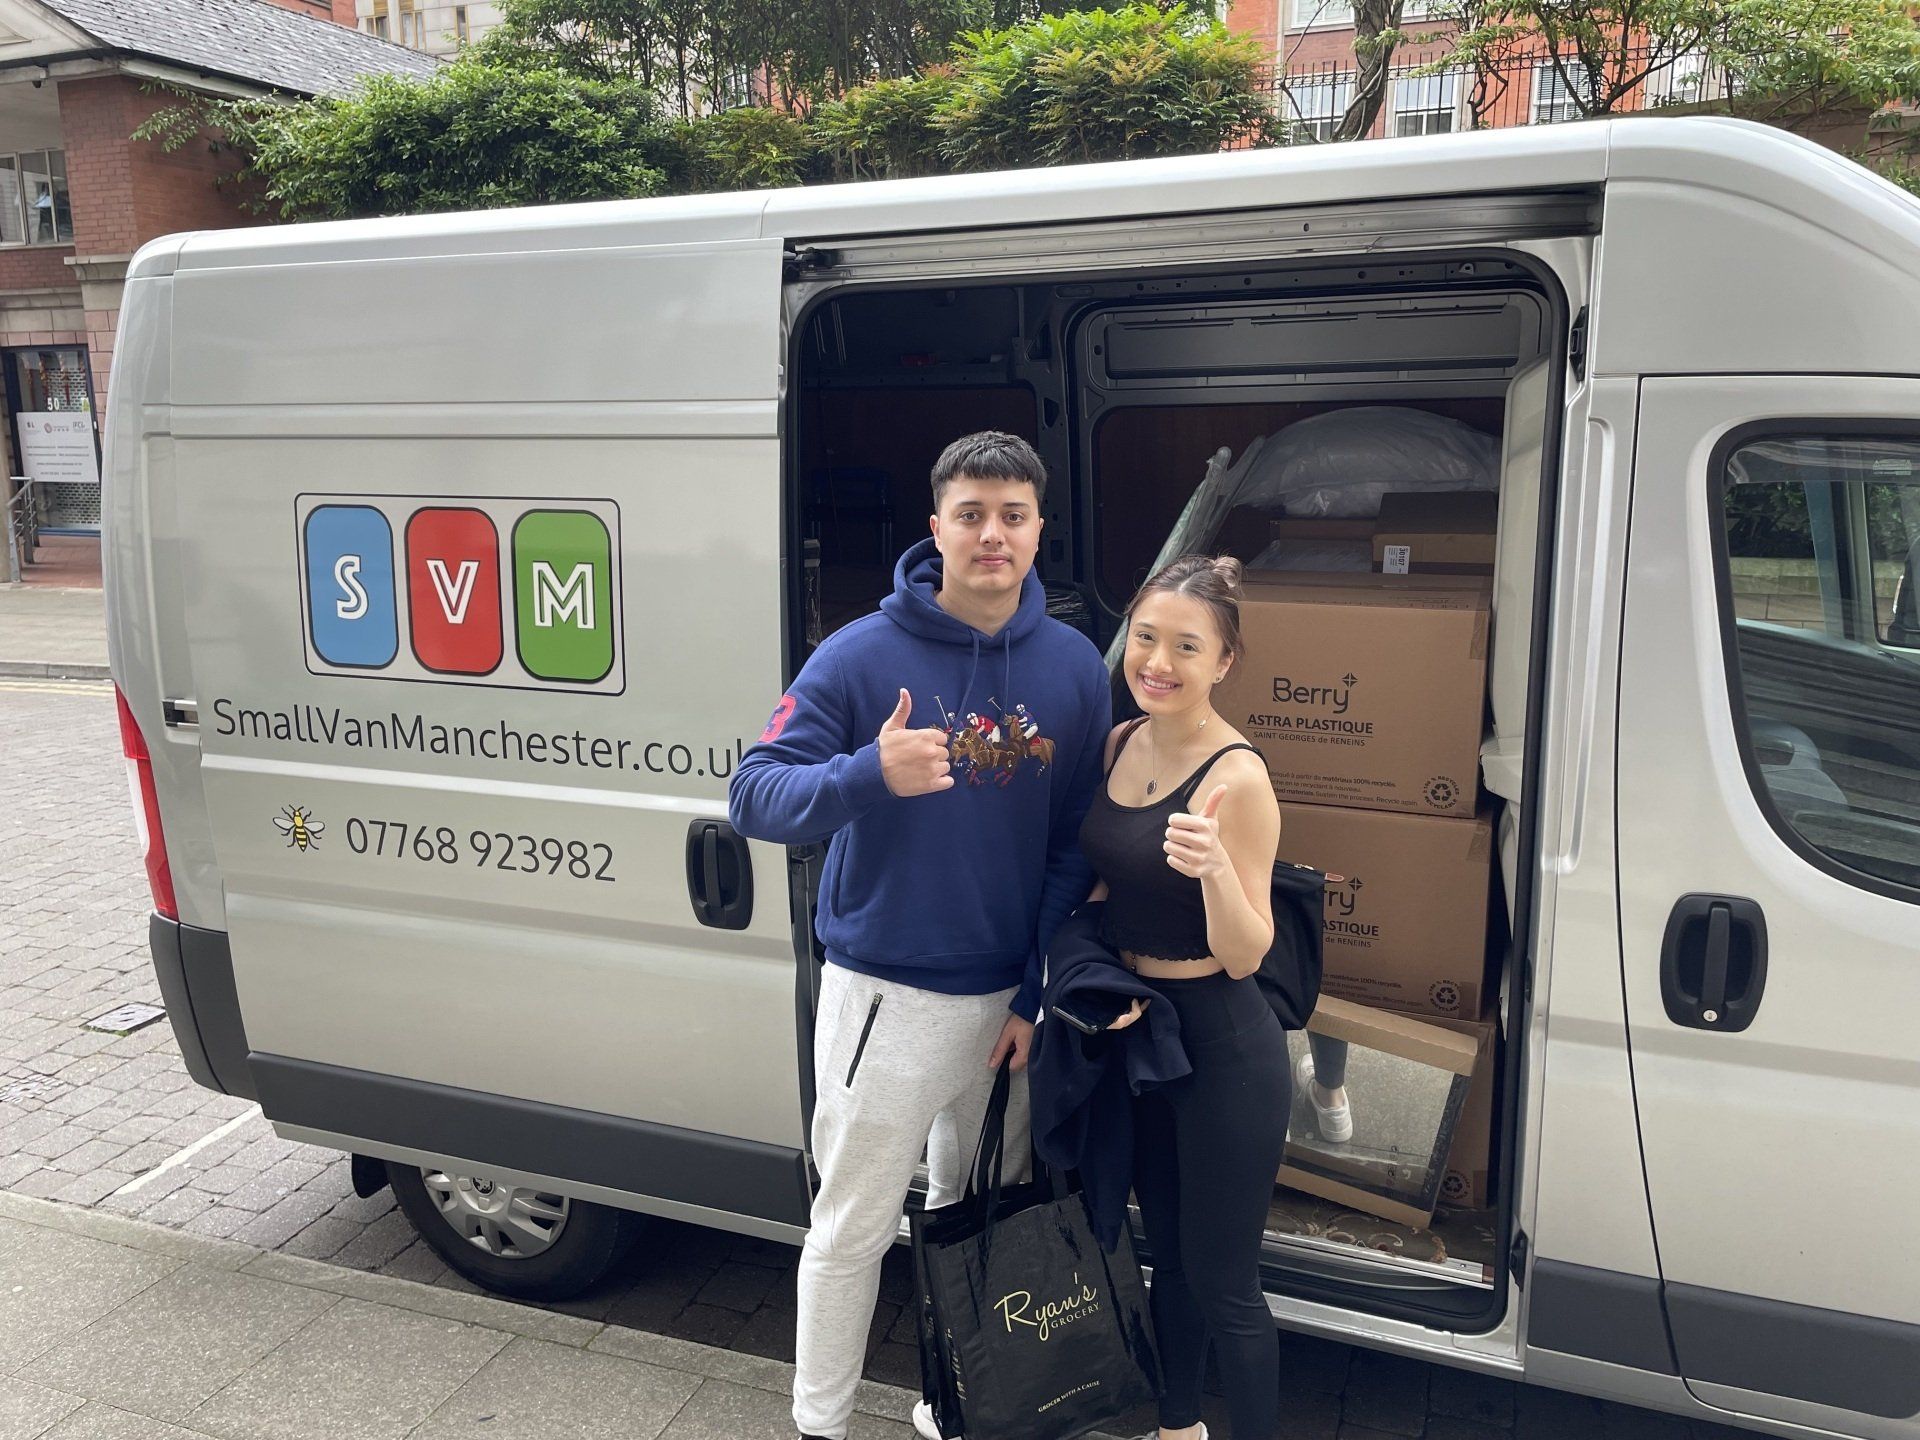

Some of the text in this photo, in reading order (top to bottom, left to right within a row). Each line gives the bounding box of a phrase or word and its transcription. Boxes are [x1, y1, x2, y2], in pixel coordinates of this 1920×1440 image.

[47, 397, 60, 411] 50
[1273, 676, 1349, 714] Berry
[758, 694, 797, 743] 3
[1247, 714, 1374, 735] ASTRA PLASTIQUE
[1253, 731, 1276, 740] SAINT
[1279, 733, 1316, 743] GEORGES
[1330, 737, 1366, 747] RENEINS
[346, 817, 617, 883] 07768 923982
[1321, 919, 1379, 937] ASTIQUE
[1325, 936, 1372, 949] de RENEINS
[993, 1271, 1097, 1342] Ryan's
[1051, 1301, 1100, 1330] GROCERY
[1038, 1397, 1061, 1413] GROCER
[1061, 1388, 1076, 1400] WITH
[1081, 1380, 1100, 1390] CAUSE
